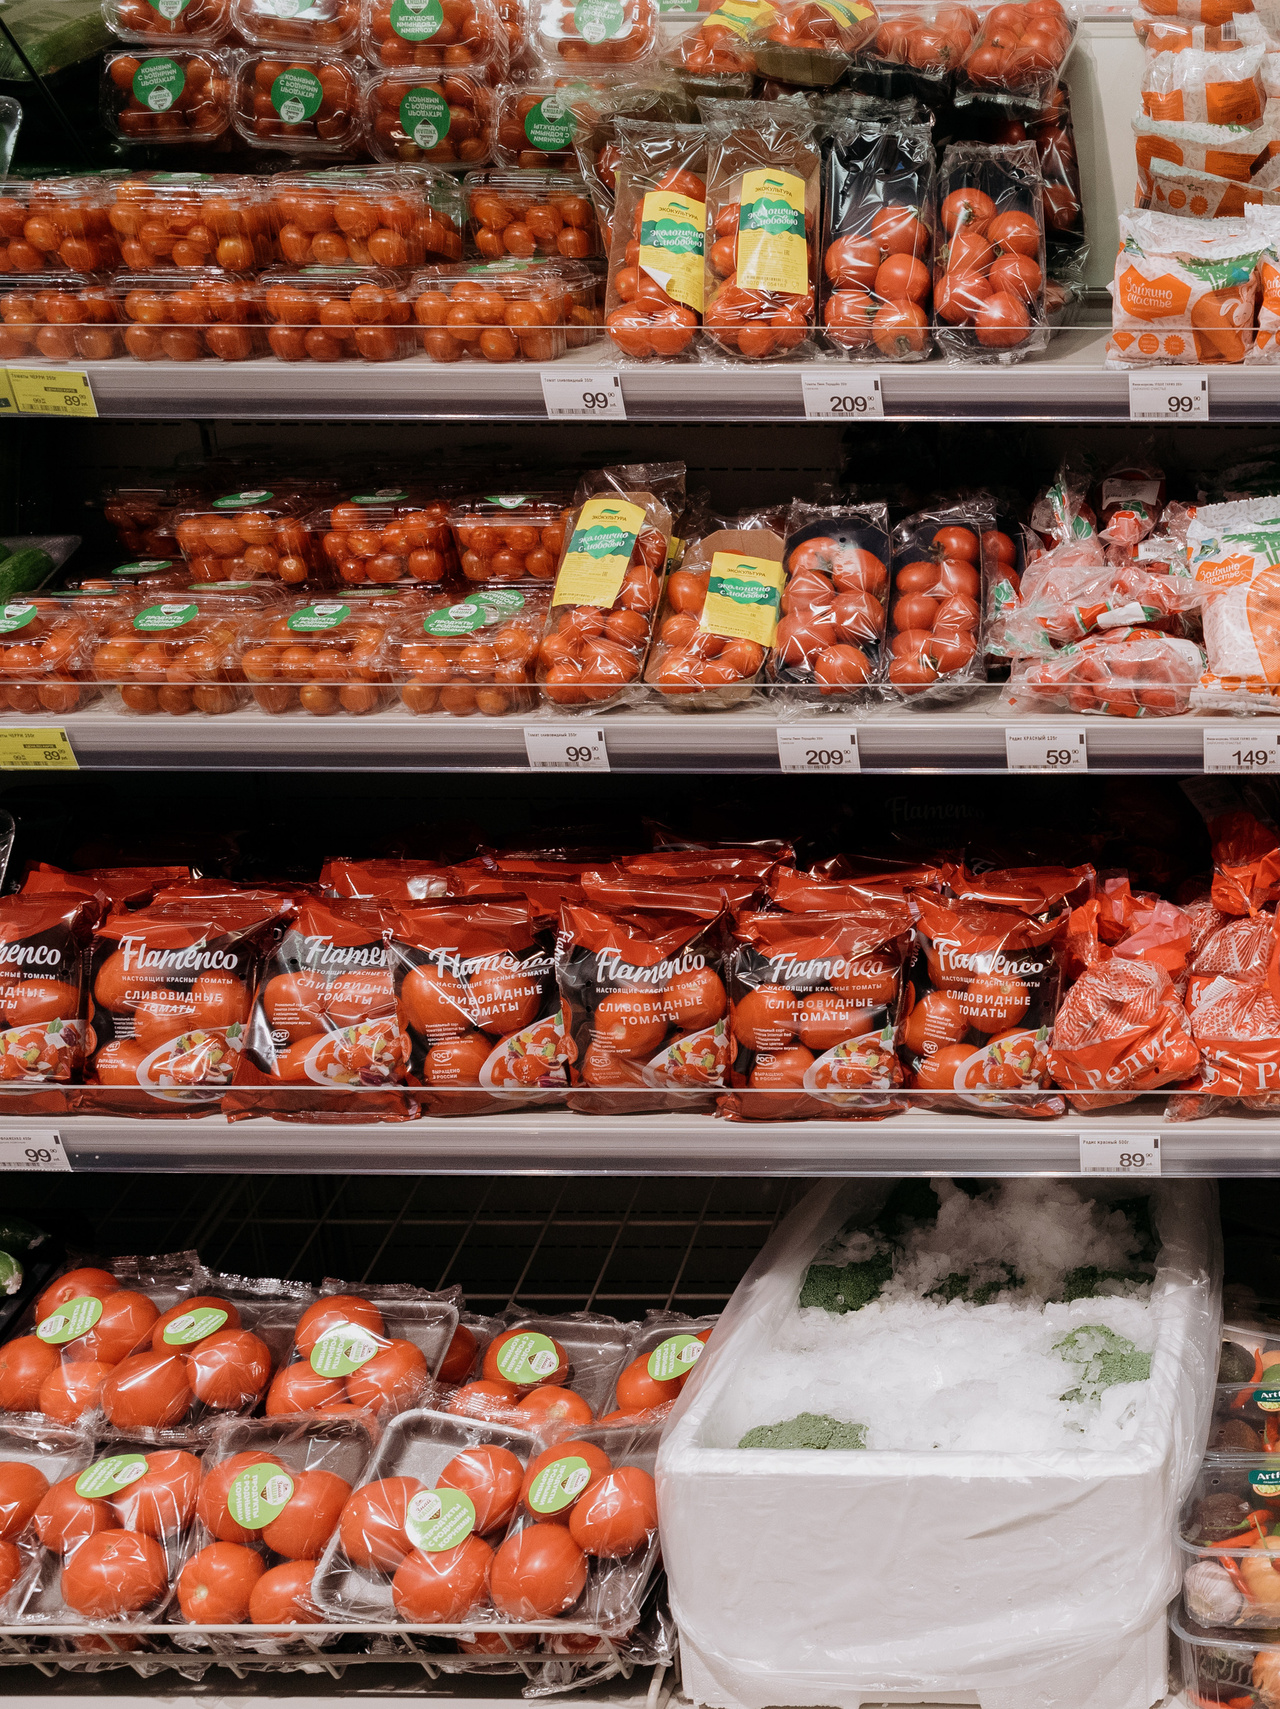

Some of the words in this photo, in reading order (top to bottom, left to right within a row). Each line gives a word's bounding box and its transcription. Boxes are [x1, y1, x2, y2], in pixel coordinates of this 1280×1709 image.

[659, 206, 699, 221] ЭКОКУЛЬТУРА
[1127, 291, 1173, 308] счастье
[64, 395, 80, 406] 89
[582, 392, 609, 409] 99
[829, 396, 868, 412] 209
[1167, 396, 1193, 412] 99
[592, 514, 627, 522] ЭКОКУЛЬТУРА
[43, 750, 61, 761] 89
[565, 746, 592, 762] 99
[805, 750, 844, 765] 209
[1046, 750, 1072, 765] 59
[1231, 750, 1268, 765] 149
[118, 935, 239, 972] Flamenco
[933, 938, 1044, 976] Flamenco
[429, 947, 555, 979] Flamenco
[595, 947, 706, 985] Flamenco
[769, 952, 884, 983] Flamenco
[122, 975, 165, 984] НАСТОЯЩИЕ
[166, 976, 198, 984] КРАСНЫЕ
[200, 977, 233, 985] ТОМАТЫ
[124, 990, 224, 1003] СЛИВОВИДНЫЕ
[437, 985, 544, 1005] СЛИВОВИДНЫЕ
[946, 990, 1031, 1007] СЛИВОВИДНЫЕ
[598, 996, 703, 1013] СЛИВОВИДНЫЕ
[768, 998, 874, 1009] СЛИВОВИДНЫЕ
[959, 1004, 1007, 1019] ТОМАТЫ
[620, 1012, 680, 1026] ТОМАТЫ
[792, 1011, 849, 1022] ТОМАТЫ
[25, 1148, 52, 1162] 99
[1119, 1153, 1145, 1167] 89
[424, 1503, 461, 1540] ПРОДУКТЫ
[434, 1508, 469, 1543] РОДНЫМИ
[438, 1515, 472, 1549] КОРНЯМИ
